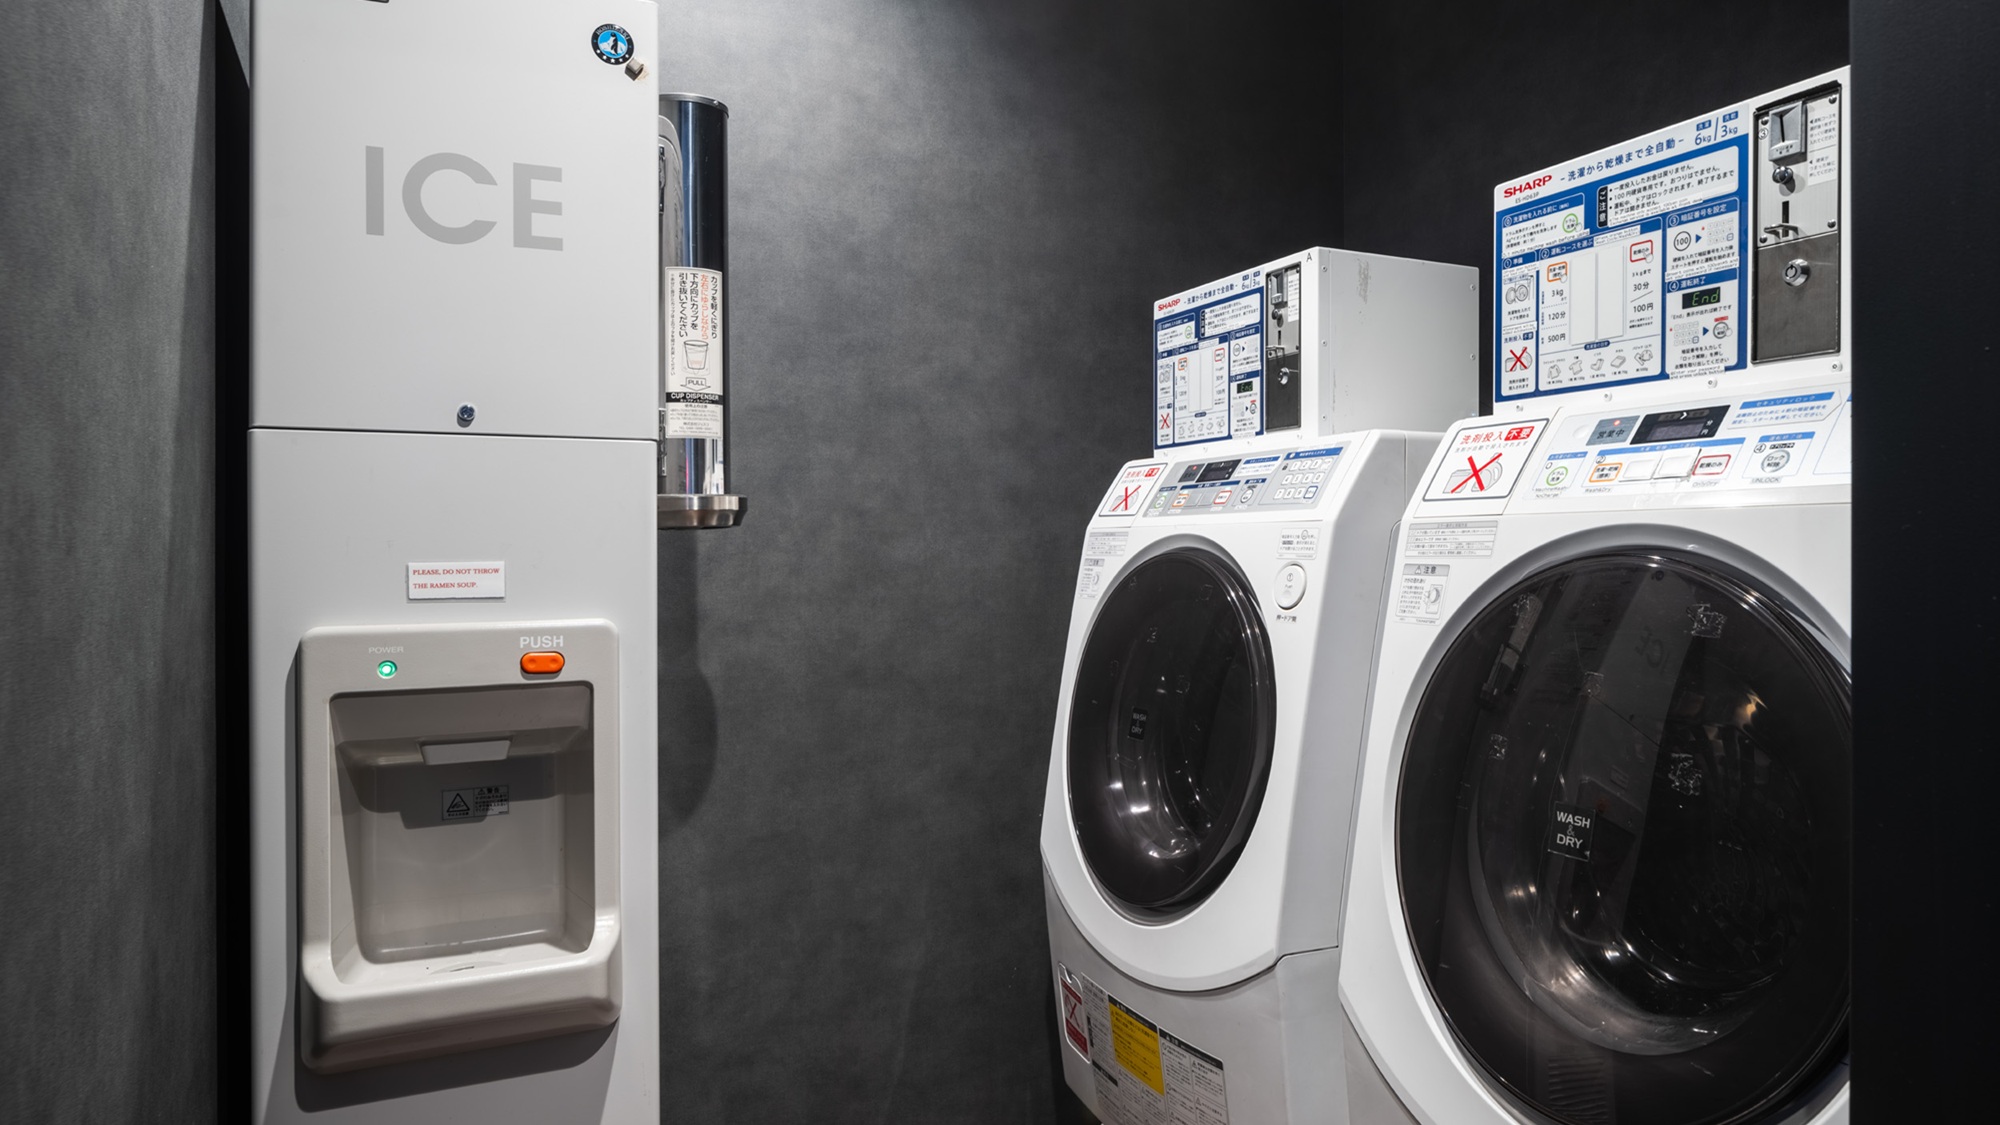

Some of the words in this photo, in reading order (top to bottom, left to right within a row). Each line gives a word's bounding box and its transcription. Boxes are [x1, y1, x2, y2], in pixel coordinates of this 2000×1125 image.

[1504, 174, 1552, 198] SHARP
[364, 145, 564, 252] ICE
[1599, 190, 1607, 222] ご注意
[1676, 236, 1689, 246] 100
[1306, 253, 1312, 262] A
[1633, 282, 1650, 292] 30分
[1552, 289, 1564, 298] 3kg
[1692, 288, 1720, 306] End
[679, 272, 688, 338] 引き抜いてください
[690, 272, 699, 330] 下方向にカップを
[1158, 298, 1181, 311] SHARP
[700, 274, 709, 340] 左右にゆらしながら
[1633, 302, 1654, 313] 100円
[1548, 311, 1566, 320] 120分
[1548, 333, 1566, 342] 500円
[1460, 431, 1502, 445] 洗剤投入
[1508, 428, 1532, 440] 不要
[1597, 429, 1625, 440] 営業中
[412, 568, 441, 576] PLEASE,
[1423, 566, 1436, 574] 注意
[520, 635, 564, 648] PUSH
[368, 646, 404, 654] POWER
[1133, 712, 1147, 721] WASH
[1131, 726, 1142, 734] DRY
[1556, 811, 1590, 829] WASH
[1567, 824, 1576, 836] &
[1556, 834, 1583, 848] DRY
